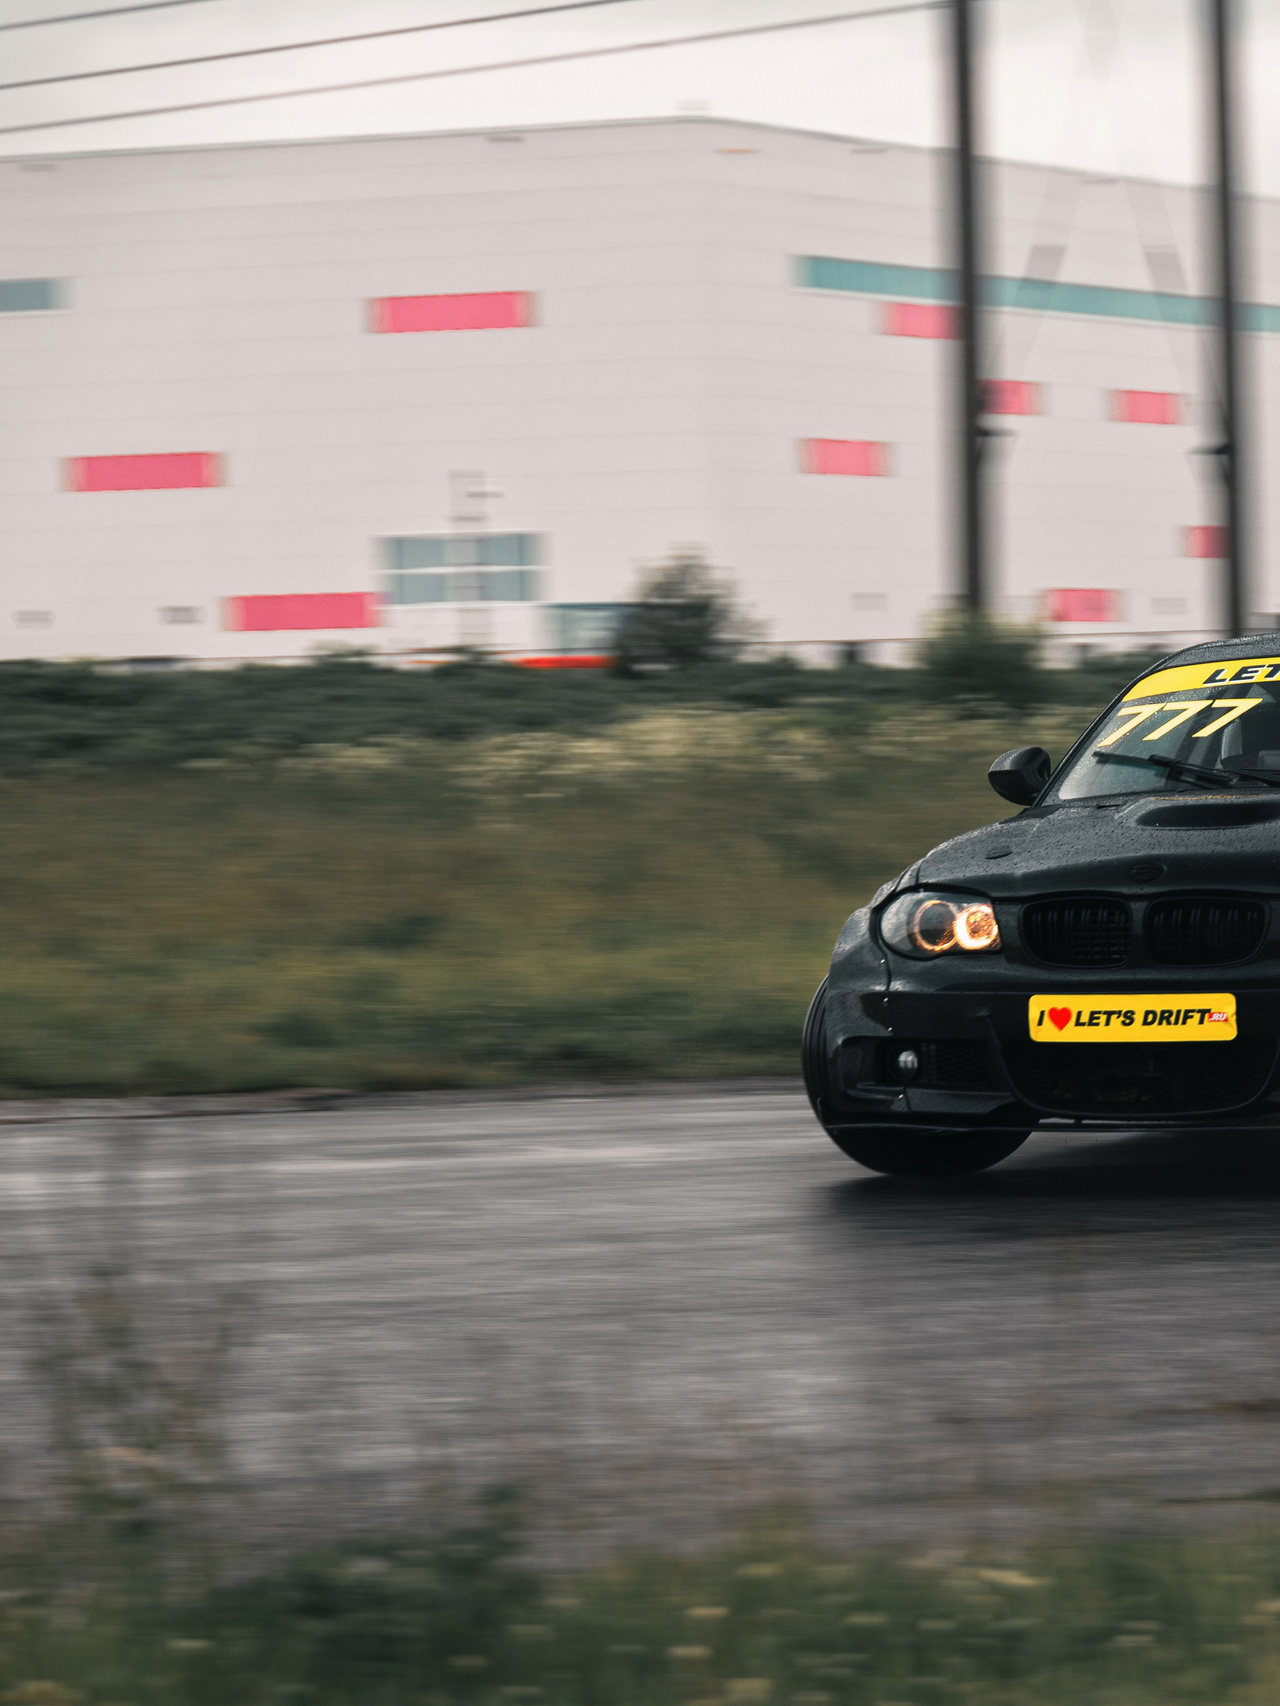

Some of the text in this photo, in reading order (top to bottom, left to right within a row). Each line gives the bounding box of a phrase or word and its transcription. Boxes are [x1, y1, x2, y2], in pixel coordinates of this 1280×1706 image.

[1097, 698, 1263, 746] 777
[1036, 1010, 1045, 1026] I
[1074, 1010, 1136, 1027] LET'S
